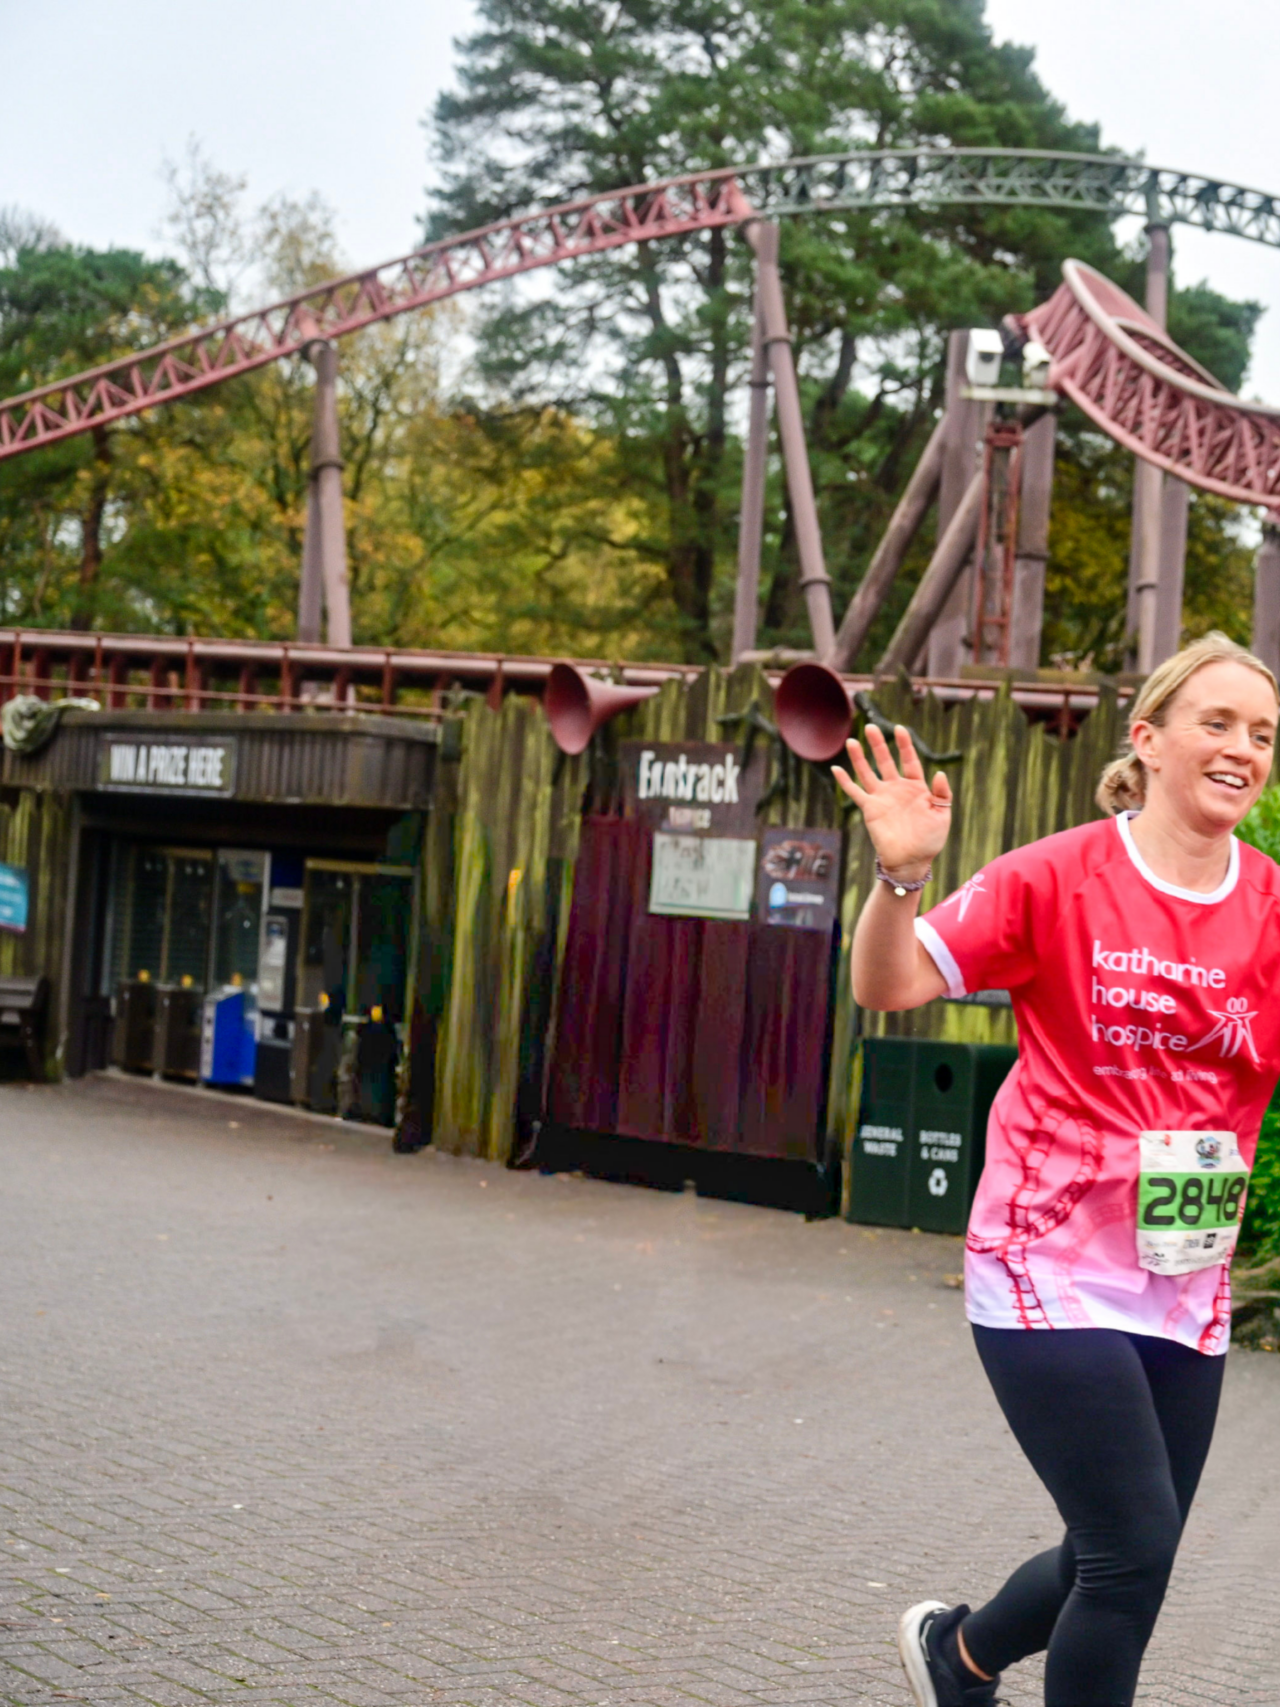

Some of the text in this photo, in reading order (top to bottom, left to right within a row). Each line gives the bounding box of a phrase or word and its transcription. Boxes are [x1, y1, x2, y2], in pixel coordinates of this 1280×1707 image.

[136, 745, 148, 783] A
[148, 745, 188, 785] PRIZE
[188, 747, 225, 787] HERE
[1092, 975, 1177, 1015] house
[1091, 1014, 1188, 1052] hospice
[860, 1124, 904, 1142] GENERAL
[919, 1130, 962, 1147] BOTTLES
[863, 1141, 898, 1157] WASTE
[920, 1146, 959, 1163] & CANS
[1143, 1176, 1246, 1226] 2848
